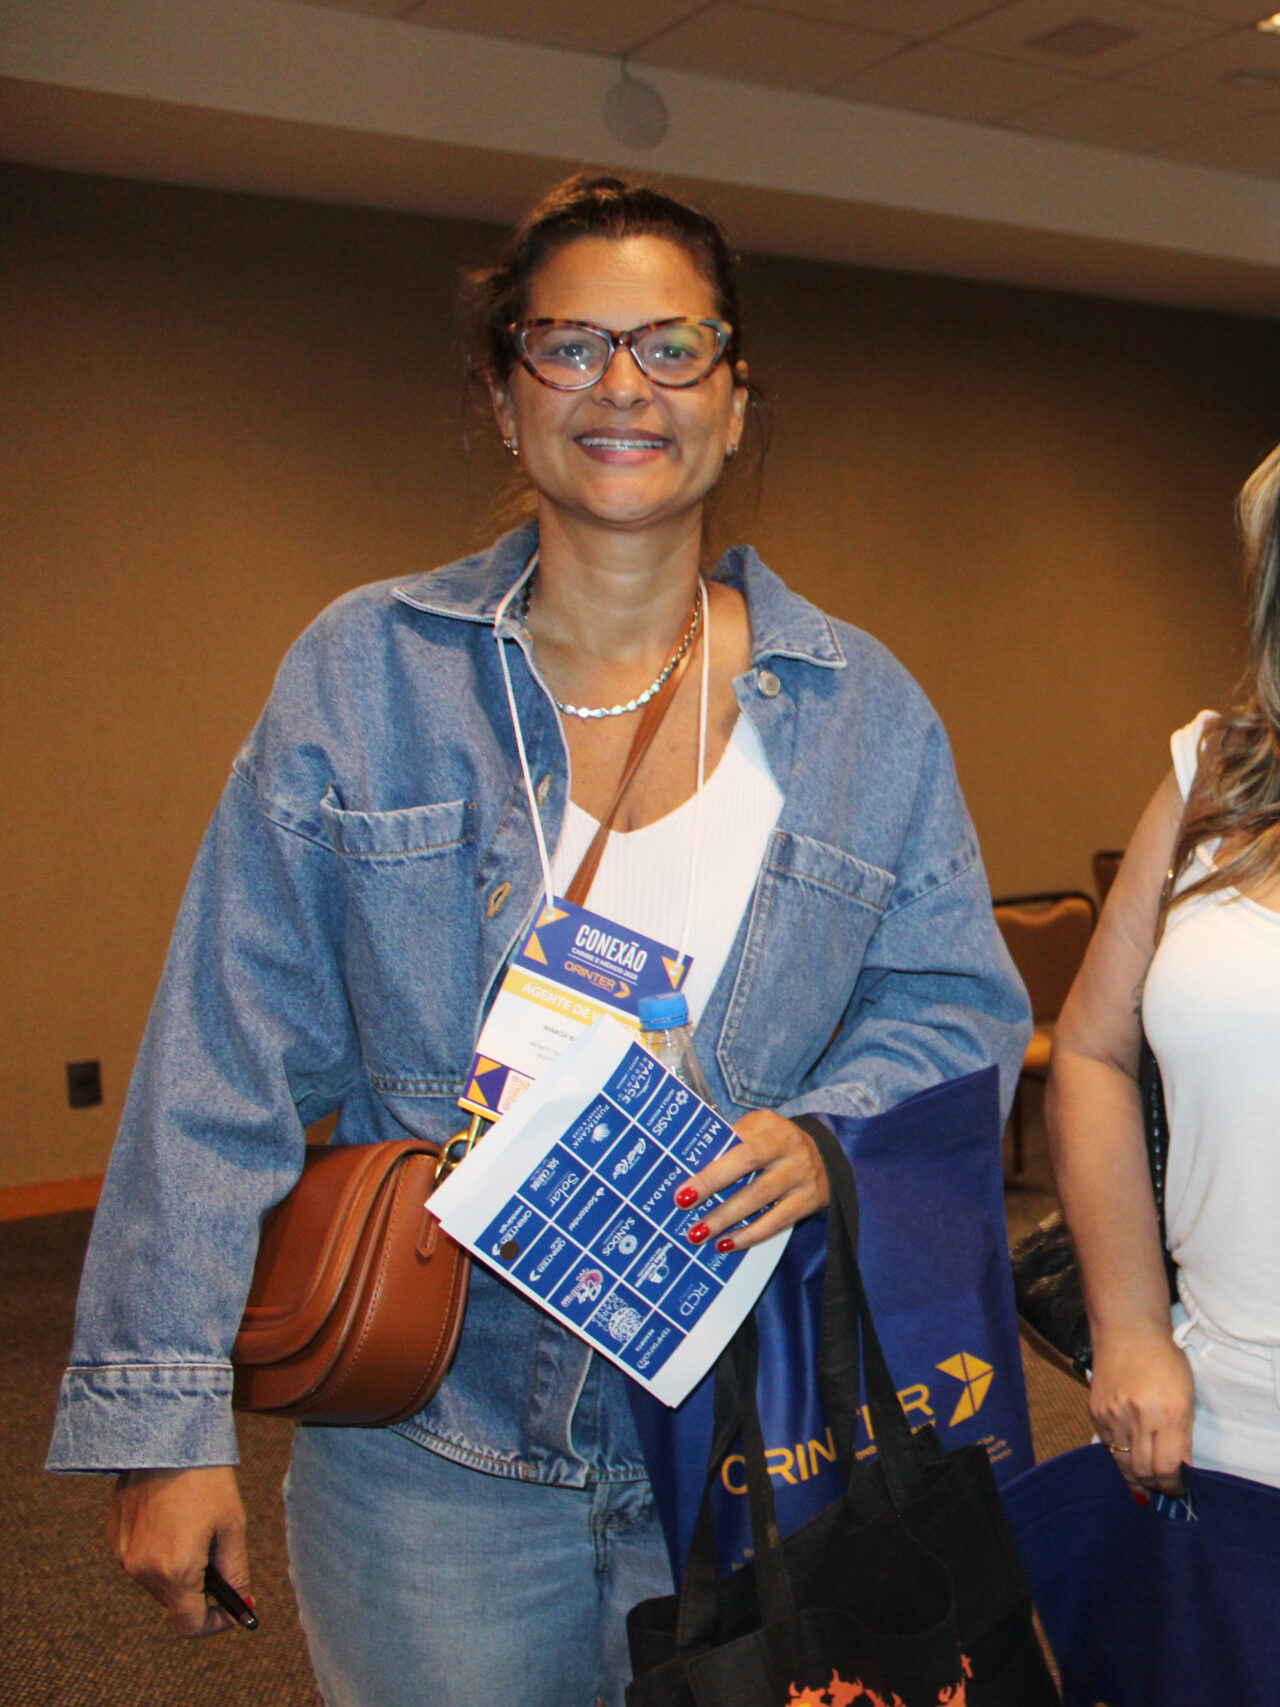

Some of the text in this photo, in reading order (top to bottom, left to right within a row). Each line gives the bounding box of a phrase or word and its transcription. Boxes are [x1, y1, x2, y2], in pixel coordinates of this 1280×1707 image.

[571, 947, 595, 962] CARIBE
[574, 923, 648, 973] CONEXÃO
[563, 960, 617, 990] ORINTER
[521, 982, 573, 1013] AGENTE
[572, 1001, 592, 1021] DE
[620, 1060, 655, 1105] PALACE
[572, 1103, 610, 1147] PUNTACANA
[650, 1101, 681, 1136] OASIS
[545, 1156, 560, 1171] SOL
[546, 1171, 580, 1211] Solar
[641, 1165, 682, 1213] POSADAS
[566, 1194, 599, 1232] Santander
[536, 1238, 566, 1273] ORINTER
[600, 1216, 636, 1257] SANDOS
[677, 1281, 709, 1318] RCD
[721, 1384, 934, 1495] ORINTR
